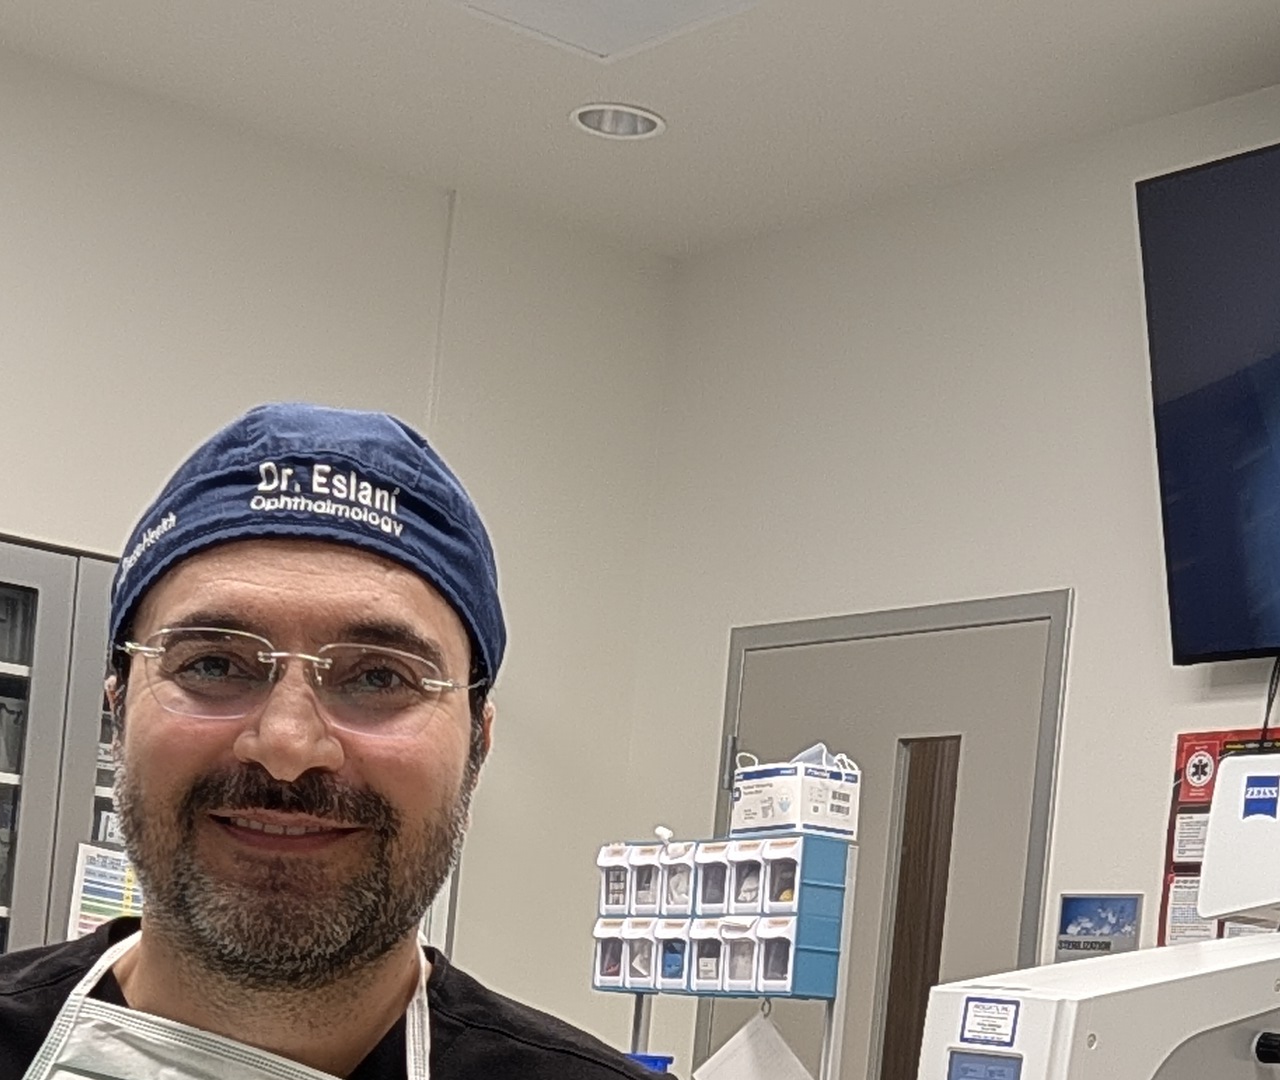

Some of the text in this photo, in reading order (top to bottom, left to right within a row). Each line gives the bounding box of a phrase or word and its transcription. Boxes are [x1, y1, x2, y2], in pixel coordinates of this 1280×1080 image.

[257, 461, 401, 516] Dr. Eslani
[250, 495, 404, 538] Ophthalmology
[1245, 787, 1278, 799] ZEISS
